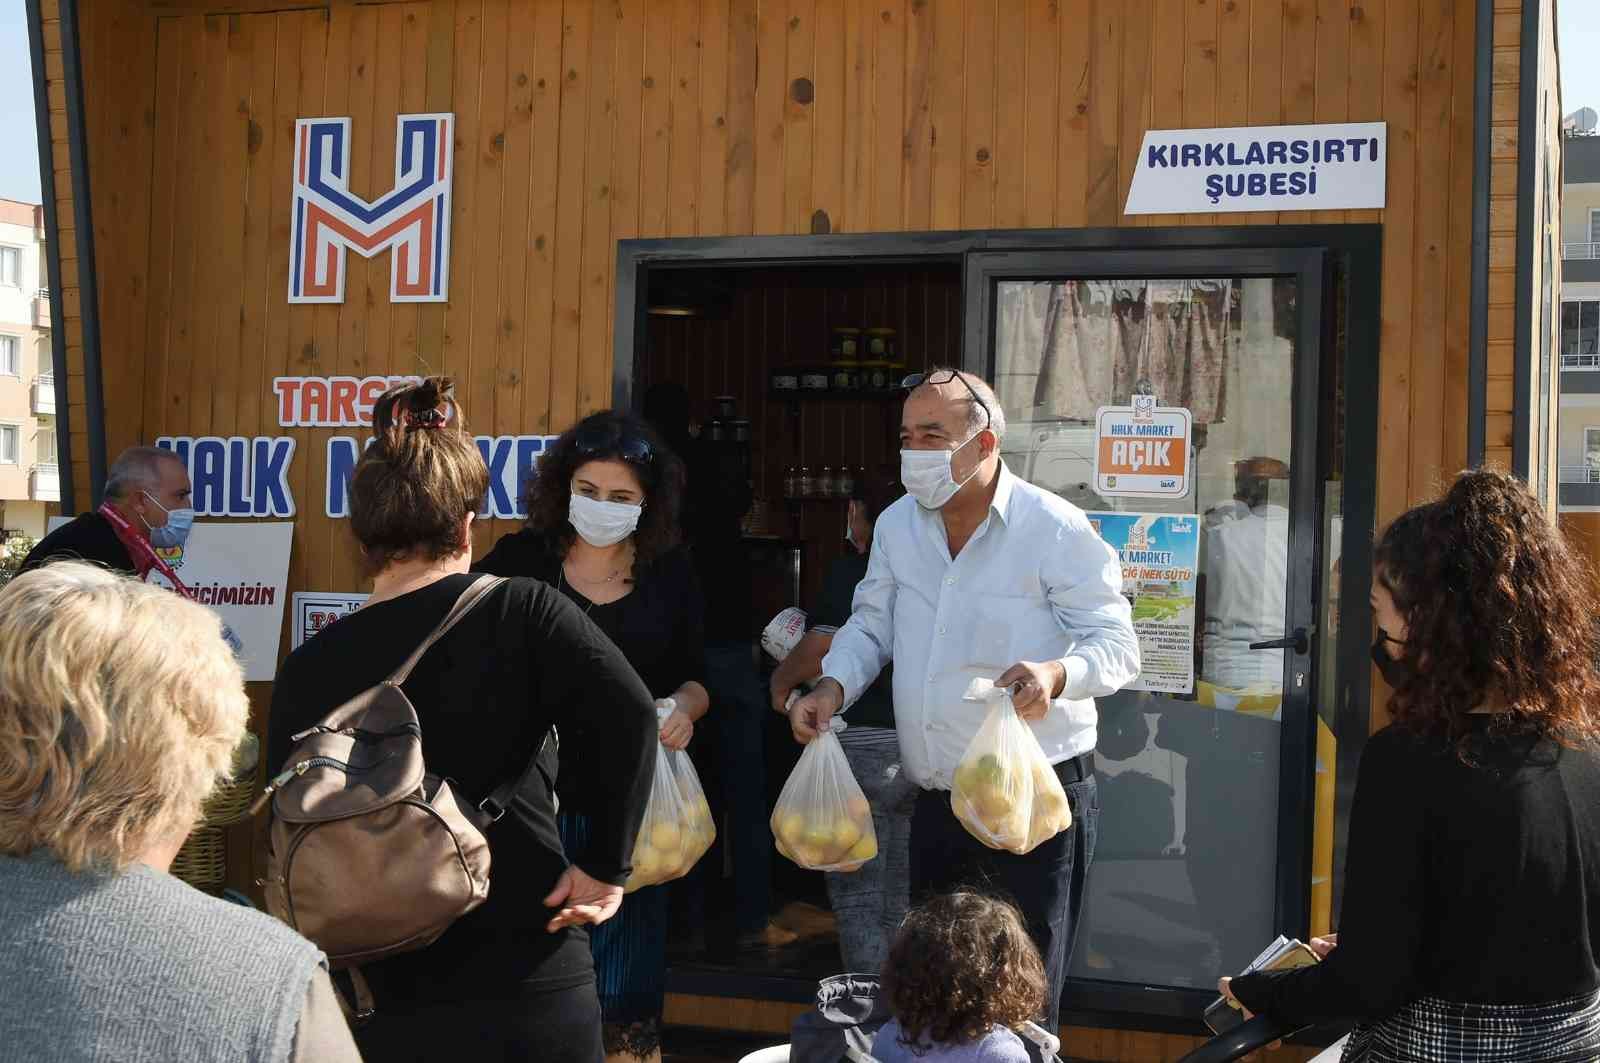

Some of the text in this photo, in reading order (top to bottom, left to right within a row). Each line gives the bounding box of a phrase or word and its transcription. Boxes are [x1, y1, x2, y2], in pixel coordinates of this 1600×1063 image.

[1148, 138, 1378, 168] KIRKLARSIRTI
[1205, 165, 1316, 204] ŞUBESİ
[276, 380, 449, 422] TARS
[1111, 425, 1174, 436] HALK MARKET
[1111, 440, 1170, 471] AÇIK
[1129, 551, 1171, 564] MARKET
